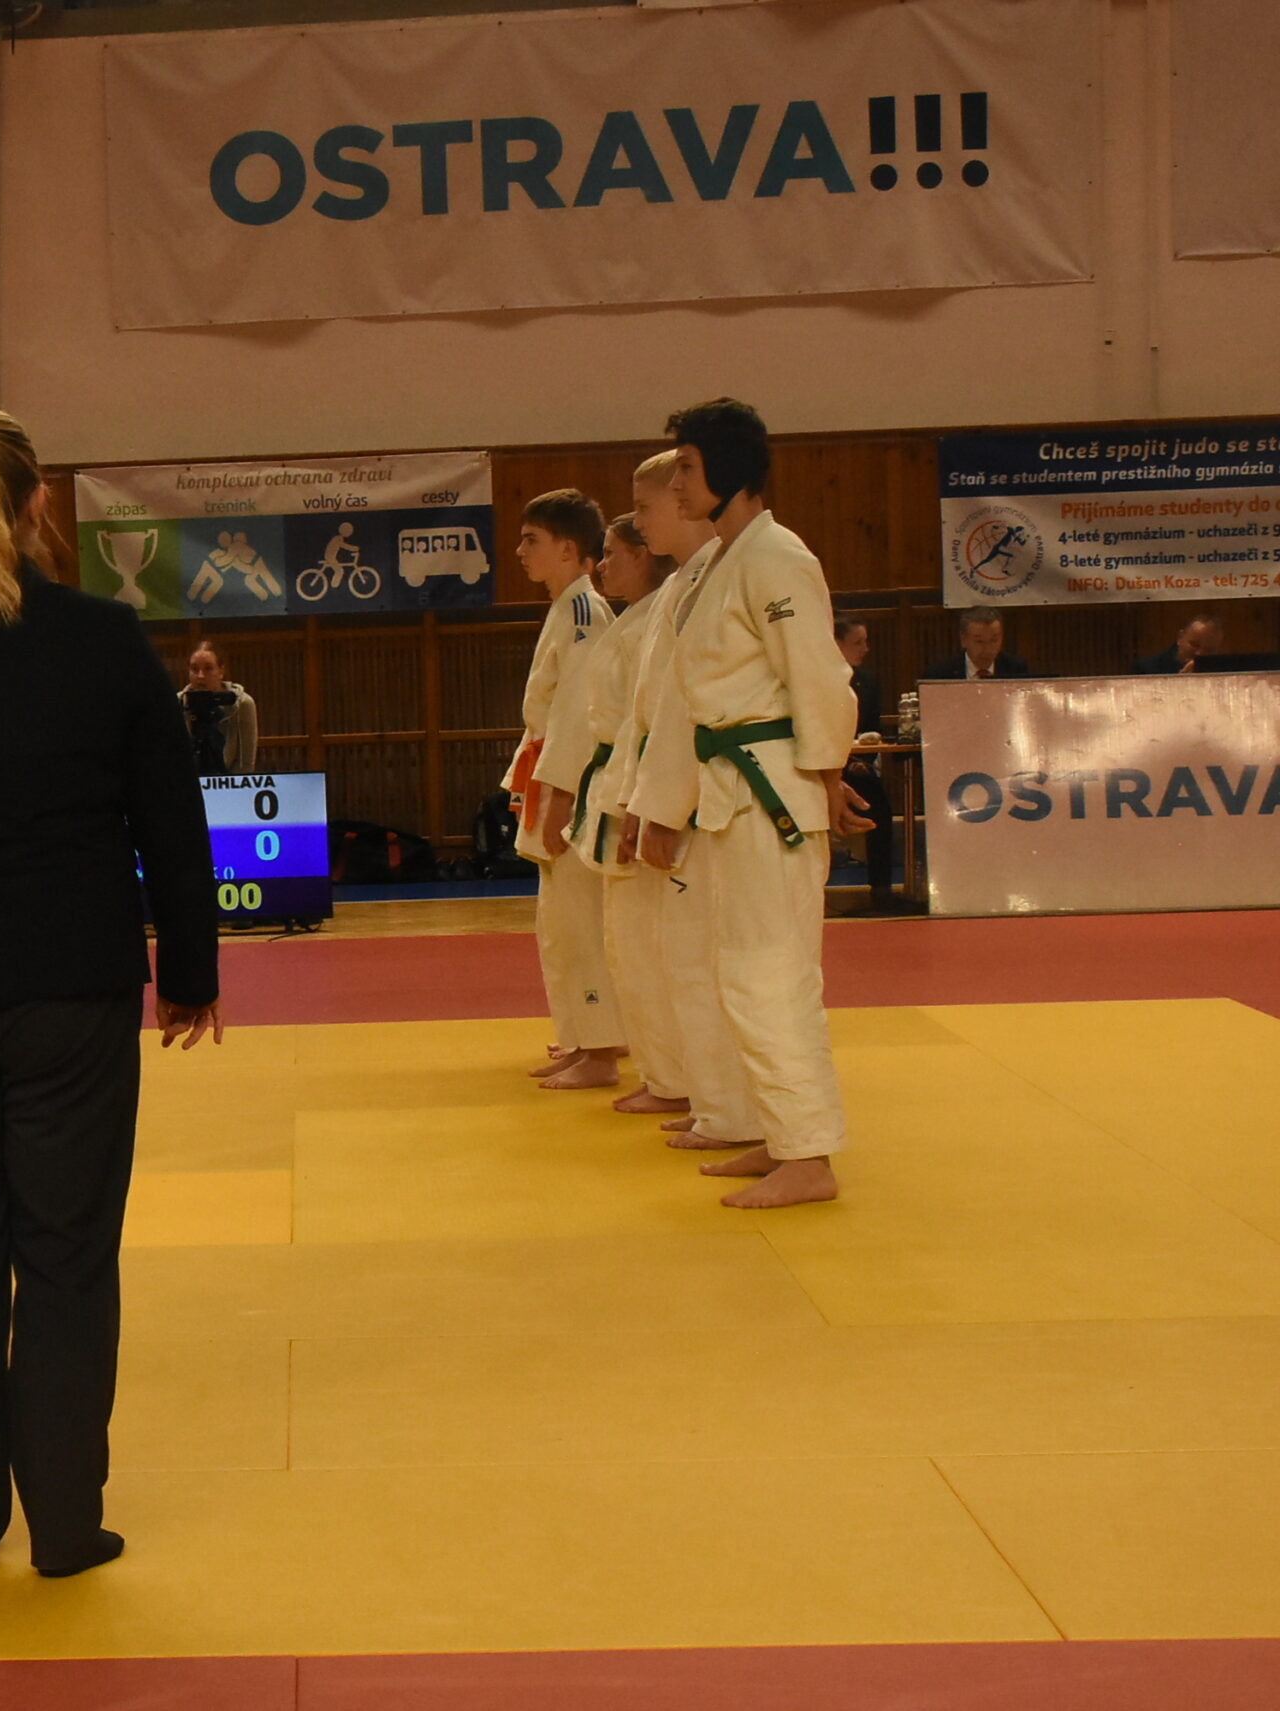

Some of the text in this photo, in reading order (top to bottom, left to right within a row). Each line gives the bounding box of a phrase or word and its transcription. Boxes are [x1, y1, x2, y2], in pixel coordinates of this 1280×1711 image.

[208, 91, 990, 226] OSTRAVA!!!
[1039, 440, 1099, 460] Chceš
[1105, 440, 1167, 462] spojit
[1171, 437, 1219, 461] judo
[1226, 439, 1250, 453] se
[175, 470, 262, 493] komplexní
[264, 469, 333, 487] ochrana
[949, 470, 985, 487] Staň
[990, 473, 1007, 485] se
[1012, 467, 1097, 485] studentem
[1101, 464, 1192, 485] prestižního
[1195, 462, 1274, 482] gymnázia
[106, 489, 460, 517] zápas trénink volný čas cesty
[1060, 501, 1155, 524] Přijímáme
[1158, 496, 1243, 518] studenty
[1248, 492, 1270, 513] do
[1058, 528, 1100, 545] 4-leté
[1103, 526, 1185, 546] gymnázium
[1197, 523, 1258, 540] uchazeči
[1260, 526, 1269, 537] z
[1059, 553, 1101, 569] 8-leté
[1104, 550, 1185, 570] gymnázium
[1197, 547, 1258, 564] uchazeči
[1260, 550, 1269, 561] z
[1067, 577, 1108, 593] INFO:
[1115, 574, 1160, 590] Dušan
[1164, 575, 1200, 590] Koza
[1213, 573, 1238, 587] tel:
[1241, 573, 1269, 588] 725
[202, 775, 276, 790] JIHLAVA
[253, 789, 280, 821] 0
[255, 830, 281, 861] 0
